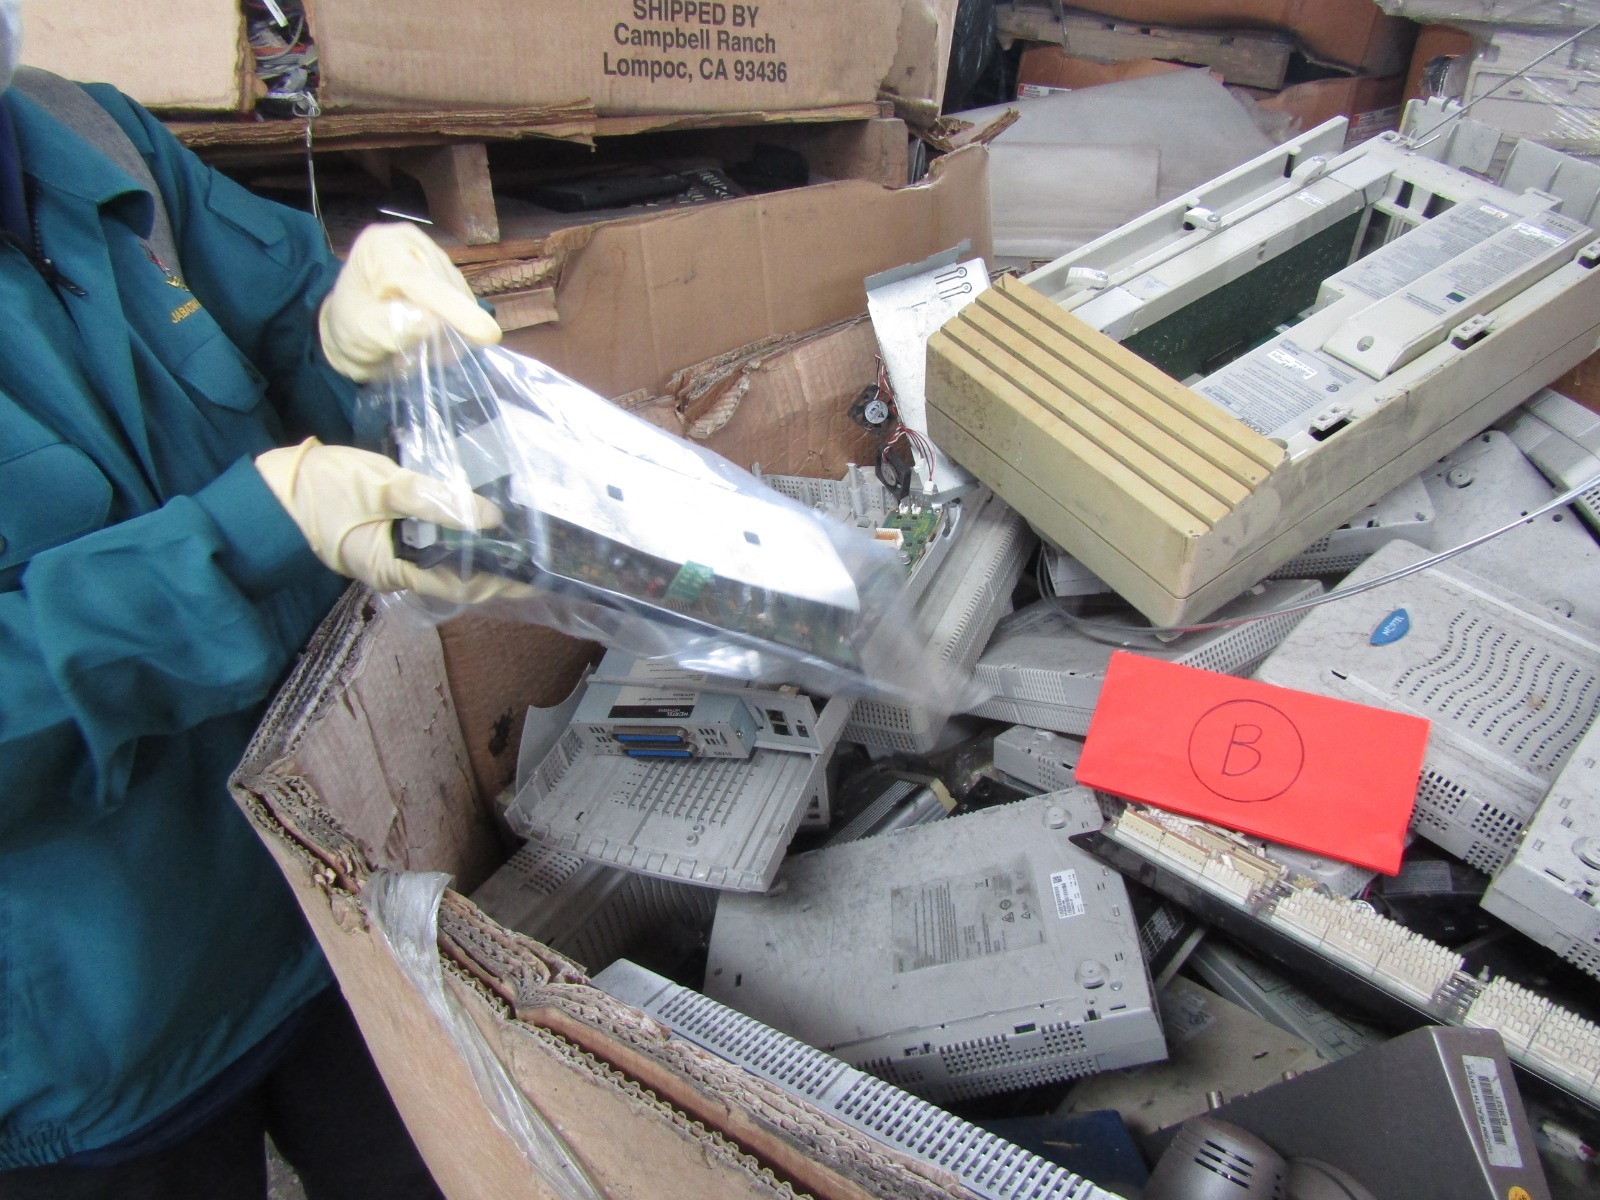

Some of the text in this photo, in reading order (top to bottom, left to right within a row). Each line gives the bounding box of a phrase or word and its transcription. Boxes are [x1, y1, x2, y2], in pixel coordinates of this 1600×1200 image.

[633, 0, 759, 28] SHIPPED BY
[614, 22, 776, 53] Campbell Ranch
[603, 52, 787, 83] Lompoc, CA 93436
[1221, 723, 1263, 777] B
[1465, 1064, 1478, 1096] CENTER
[1474, 1095, 1486, 1126] HEALTH
